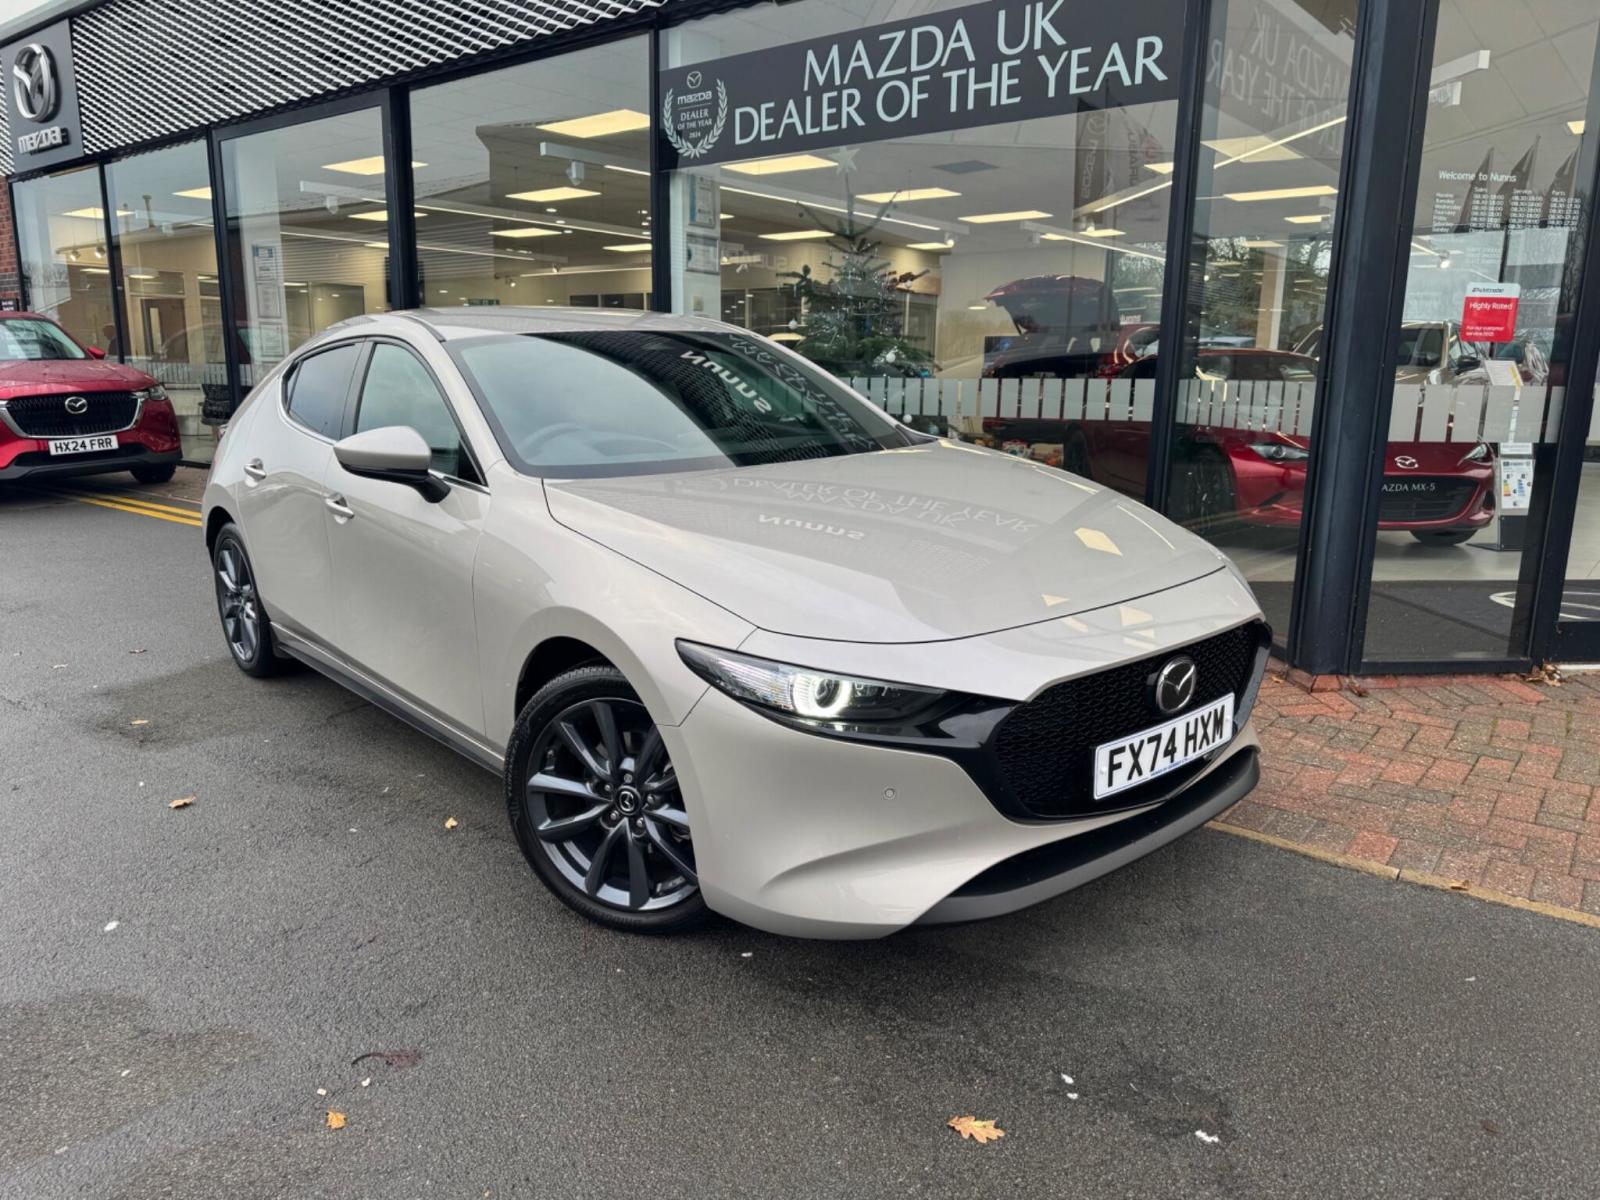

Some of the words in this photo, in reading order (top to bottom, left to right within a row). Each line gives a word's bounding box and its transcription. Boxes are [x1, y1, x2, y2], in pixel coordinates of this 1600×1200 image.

[803, 18, 975, 91] MAZDA
[997, 0, 1067, 55] UK
[735, 88, 865, 145] DEALER
[876, 75, 930, 122] OF
[943, 59, 1021, 113] THE
[1037, 36, 1168, 98] YEAR
[680, 108, 709, 121] DEALER
[686, 121, 696, 129] THE
[698, 118, 712, 127] YEAR
[1438, 170, 1476, 181] Welcome
[1478, 173, 1488, 181] to
[1490, 171, 1517, 183] Nunns
[1469, 301, 1491, 311] Highly
[1492, 301, 1514, 310] Rated
[54, 439, 87, 453] HX24
[89, 437, 112, 450] FRR
[1381, 483, 1409, 492] AZDA
[1411, 482, 1435, 492] MX-5
[1107, 727, 1178, 788] FX74
[1184, 704, 1225, 757] HXM
